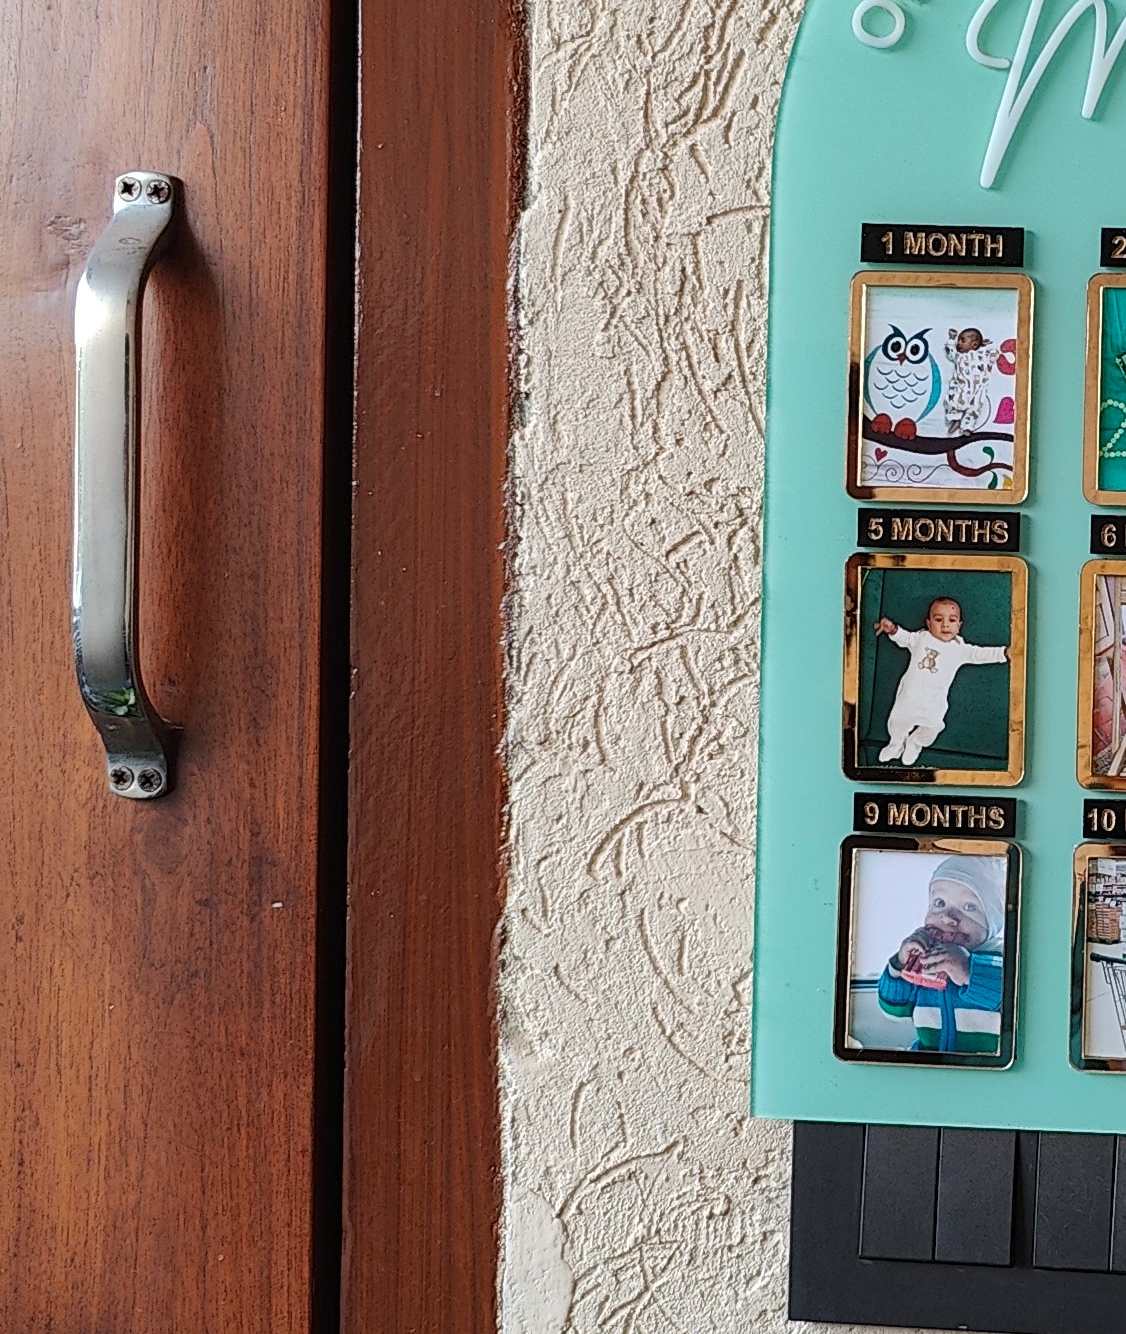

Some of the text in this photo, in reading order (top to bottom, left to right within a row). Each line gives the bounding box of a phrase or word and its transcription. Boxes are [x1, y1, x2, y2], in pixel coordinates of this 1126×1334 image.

[881, 231, 1003, 258] 1 MONTH
[1111, 235, 1126, 259] 2
[867, 517, 1009, 544] 5 MONTHS
[1100, 523, 1117, 547] 6
[863, 801, 1005, 830] 9 MONTHS
[1087, 807, 1117, 832] 10
